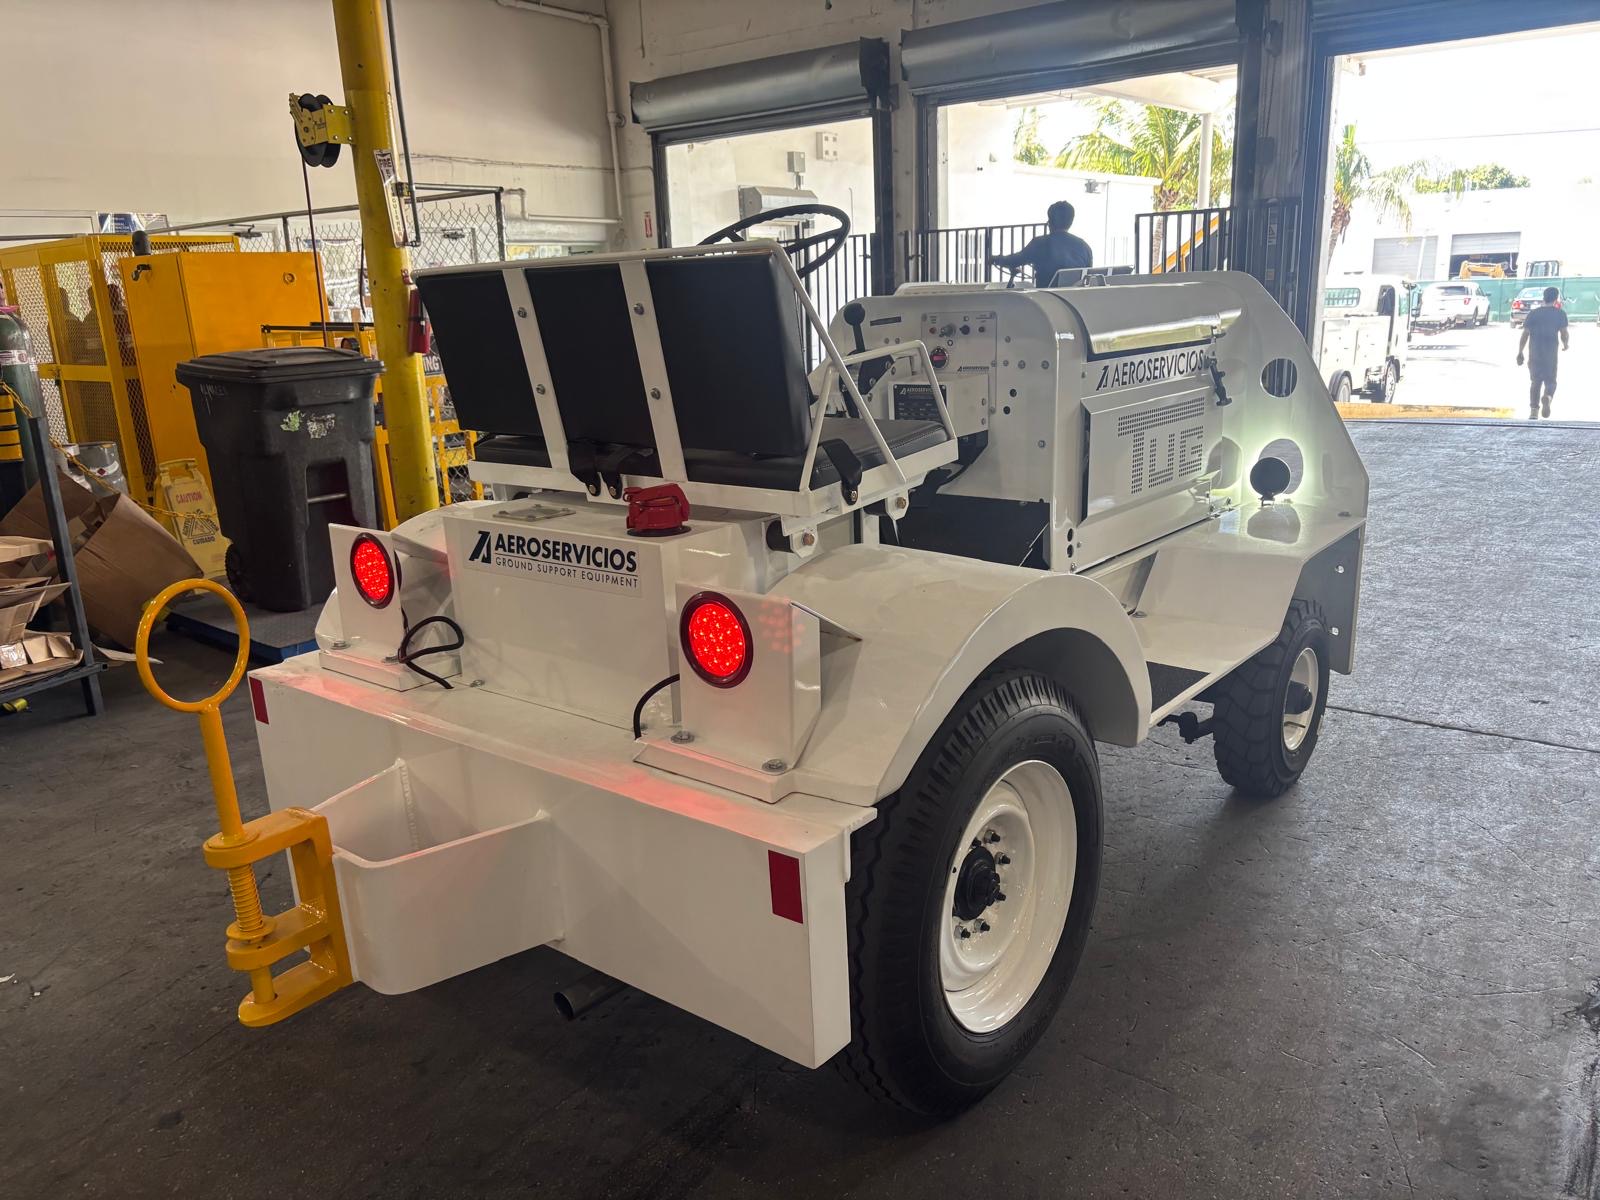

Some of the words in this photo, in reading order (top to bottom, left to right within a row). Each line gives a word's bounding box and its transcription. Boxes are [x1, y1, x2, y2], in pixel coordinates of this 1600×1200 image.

[1111, 349, 1205, 388] AEROSERVICIOS
[1117, 397, 1206, 495] TUG
[175, 491, 203, 504] CAUTION
[494, 533, 637, 573] AEROSERVICIOS
[495, 556, 533, 571] GROUND
[537, 563, 577, 579] SUPPORT
[581, 570, 638, 589] EQUIPMENT
